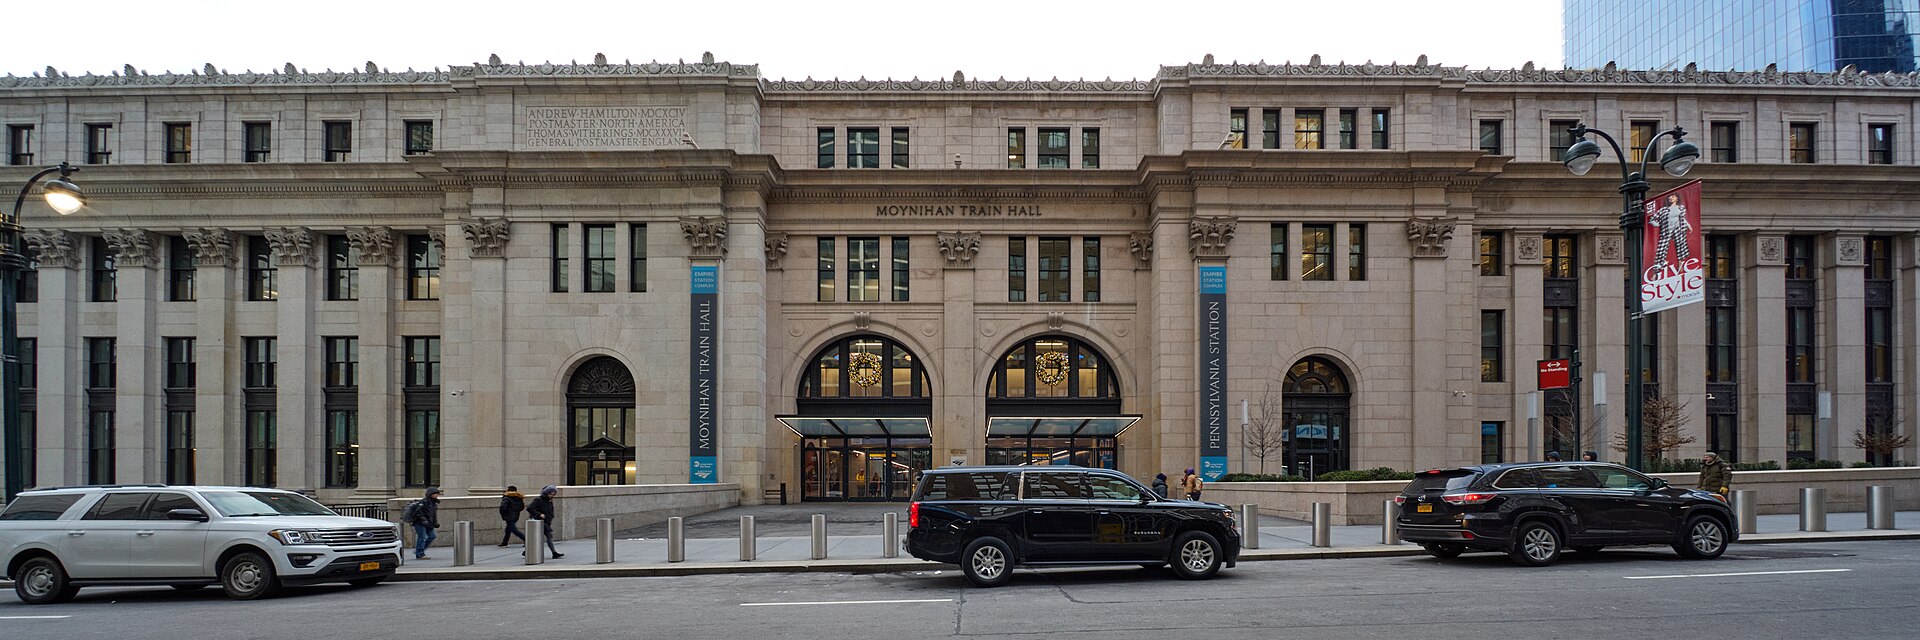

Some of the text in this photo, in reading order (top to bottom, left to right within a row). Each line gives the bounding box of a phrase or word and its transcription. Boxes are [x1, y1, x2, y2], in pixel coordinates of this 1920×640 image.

[528, 108, 686, 118] ANDREW HAMILTON MDCXCIV
[529, 119, 686, 128] POSTMASTER NORTH AMERICA
[527, 129, 569, 137] THOMAS
[571, 129, 633, 137] WITHERINGS
[527, 138, 686, 147] GENERAL POSTMASTER ENGLAN
[876, 205, 1042, 216] MOYNIHAN TRAIN HALL
[1643, 257, 1699, 284] Give
[1641, 274, 1703, 302] Style
[699, 300, 710, 331] HALL
[699, 336, 710, 375] TRAIN
[1209, 301, 1220, 449] PENNSYLVANIA STATION
[699, 379, 710, 450] MOYNIHAN
